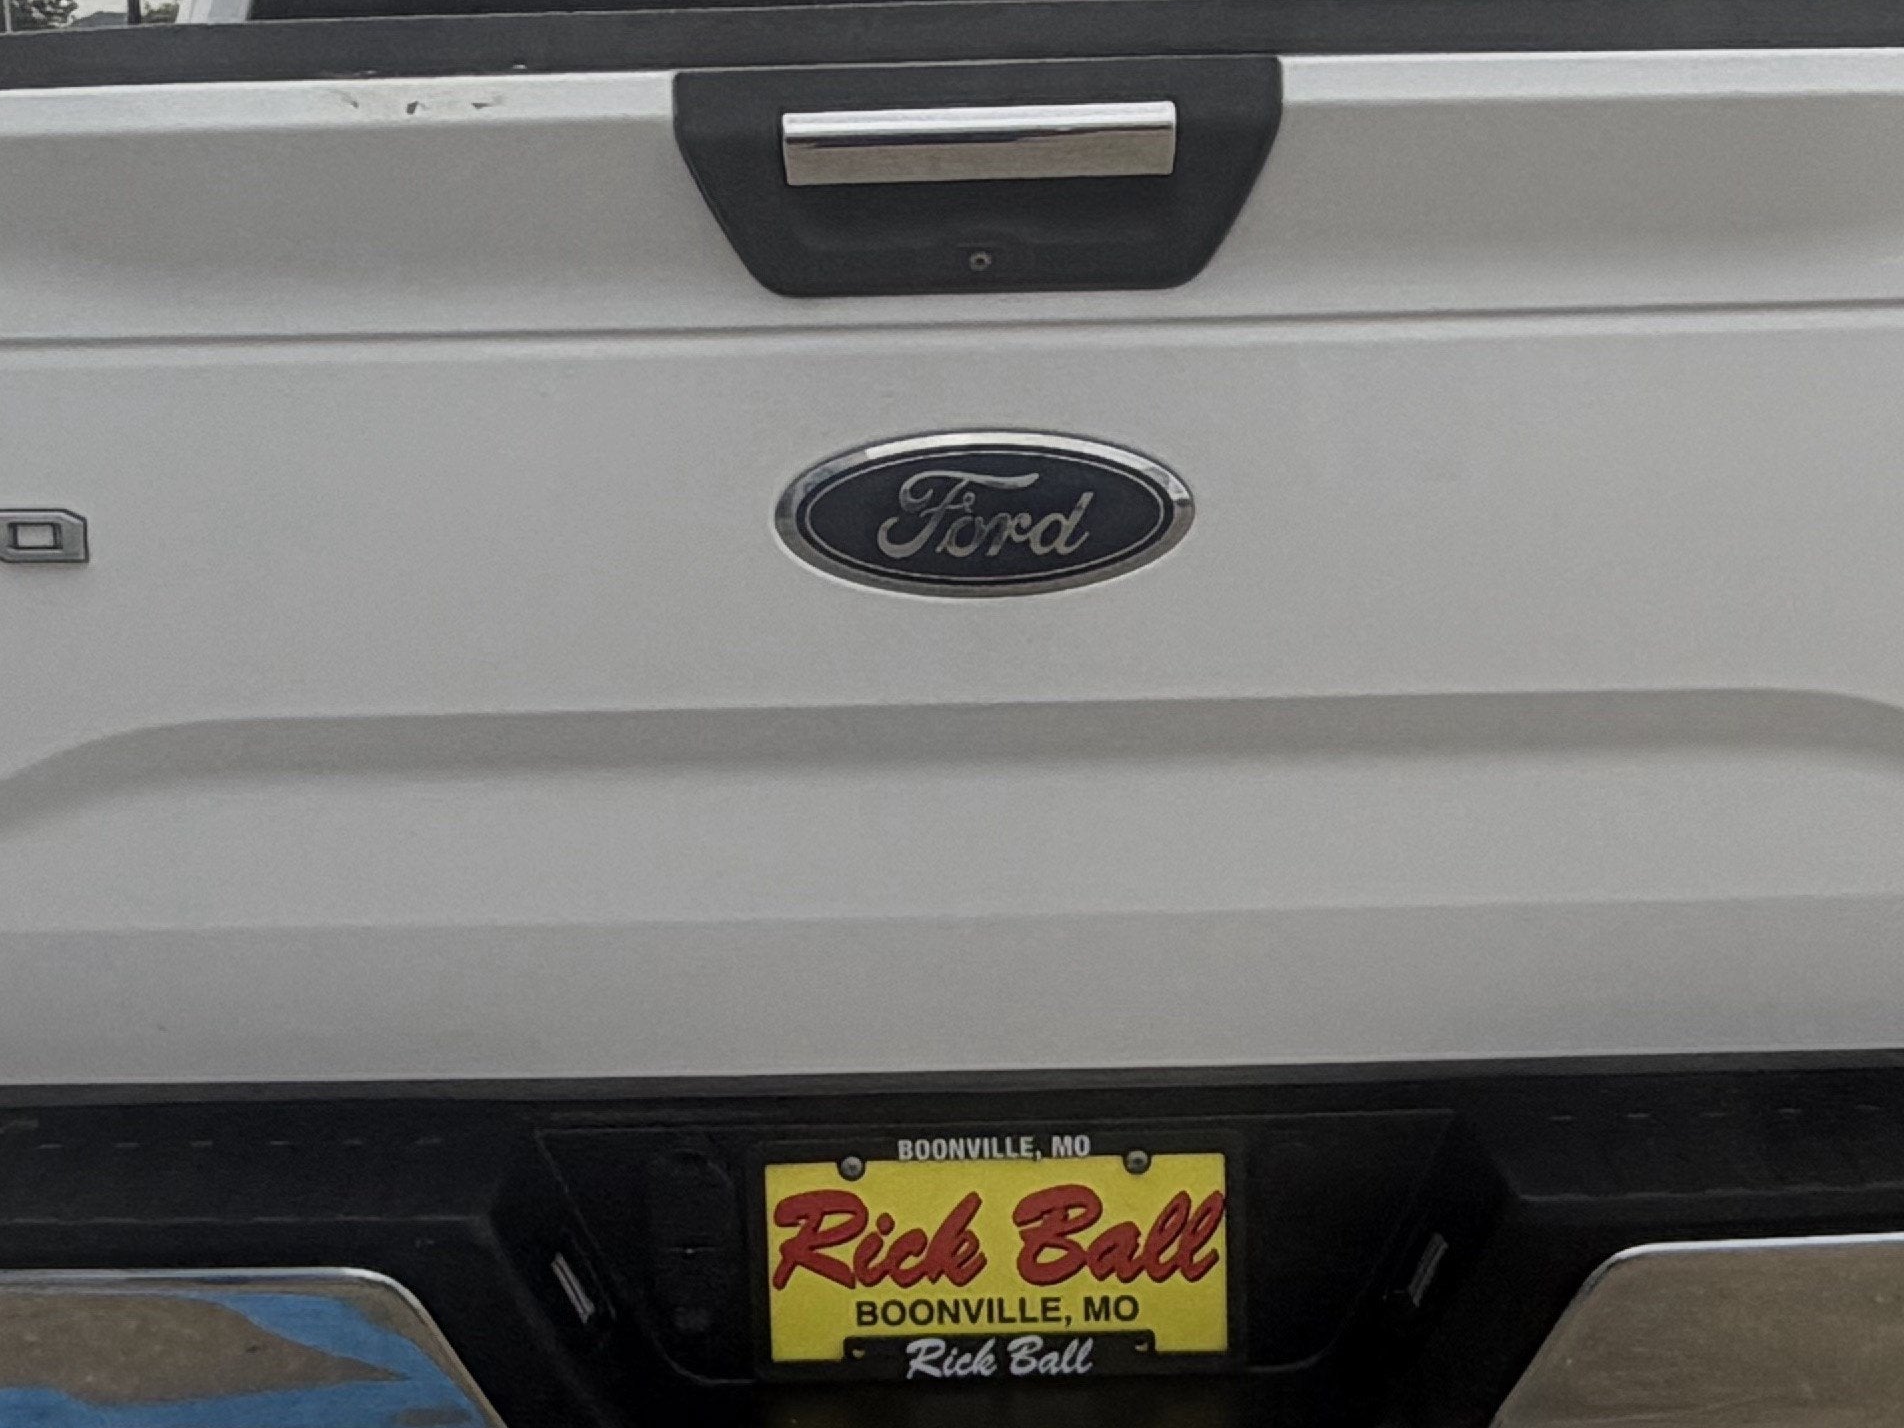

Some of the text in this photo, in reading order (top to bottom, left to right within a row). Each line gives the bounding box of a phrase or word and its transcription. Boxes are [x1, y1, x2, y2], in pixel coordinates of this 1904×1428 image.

[876, 470, 1095, 560] Ford
[898, 1135, 1090, 1161] BOONVILLE, MO
[771, 1184, 1226, 1291] Rick Ball
[856, 1295, 1139, 1328] BOONVILLE, MO
[905, 1335, 1094, 1380] Rick Ball
